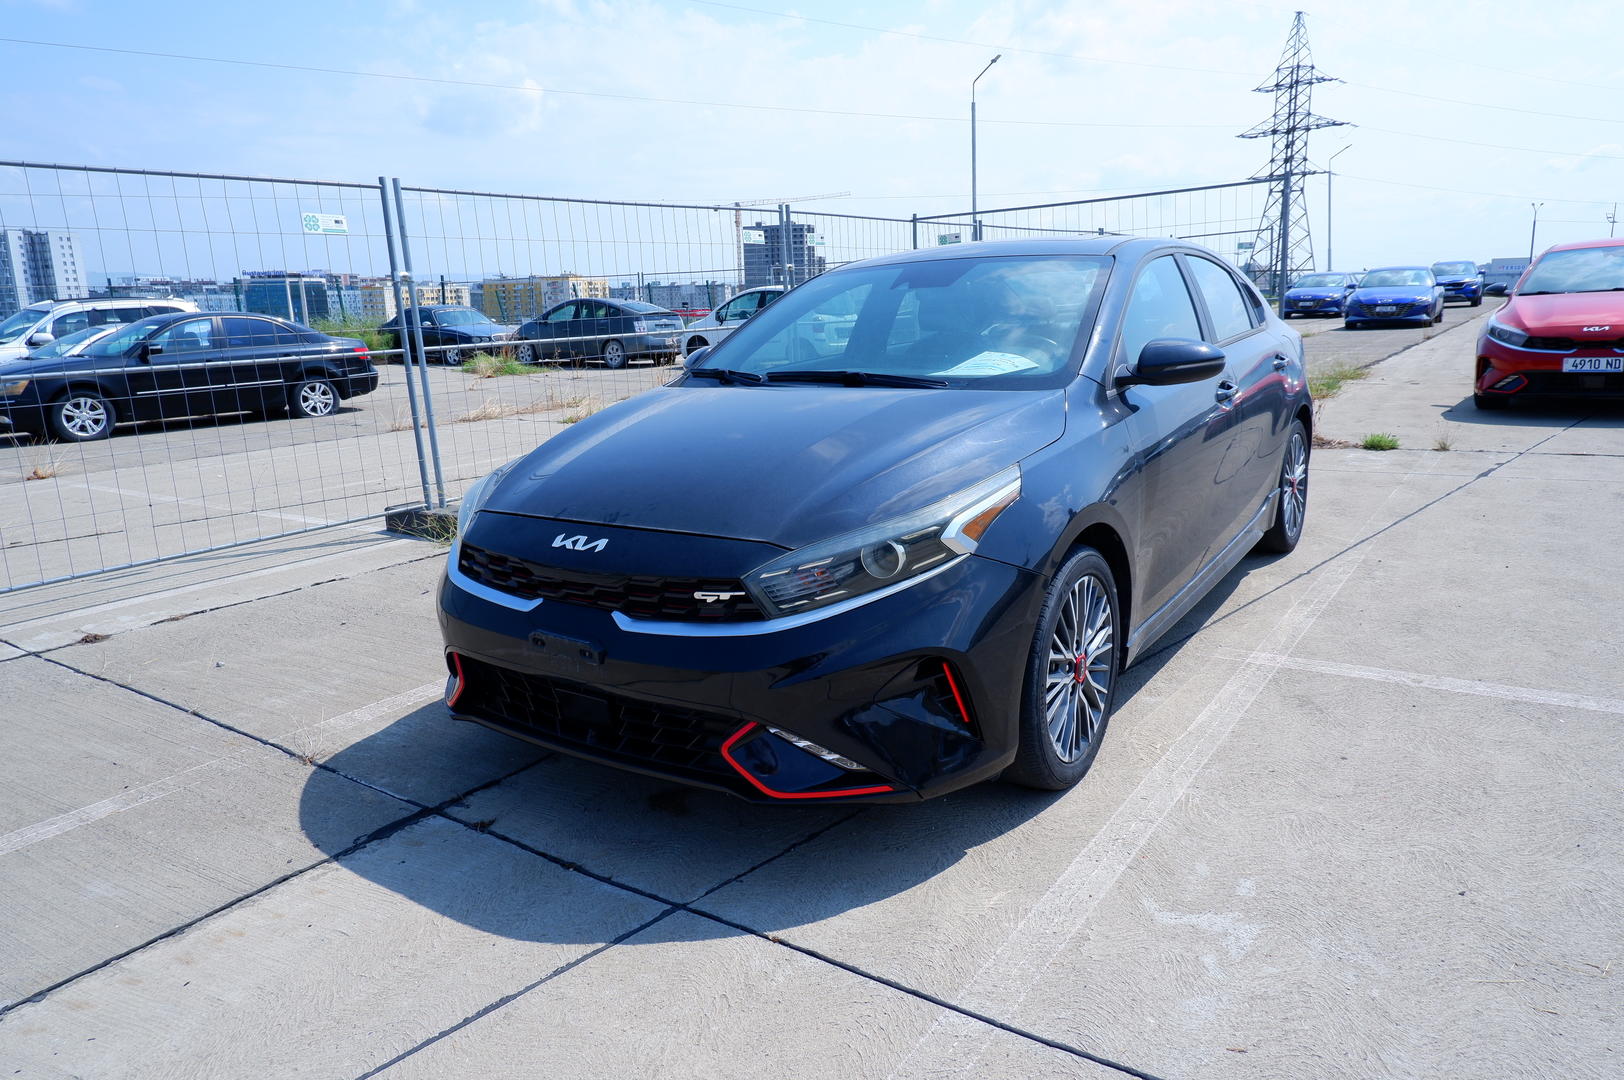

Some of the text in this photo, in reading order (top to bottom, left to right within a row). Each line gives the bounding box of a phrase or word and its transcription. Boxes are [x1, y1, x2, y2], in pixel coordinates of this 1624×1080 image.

[1572, 359, 1621, 369] 4910 ND
[552, 533, 609, 552] KIA
[694, 592, 745, 603] GT
